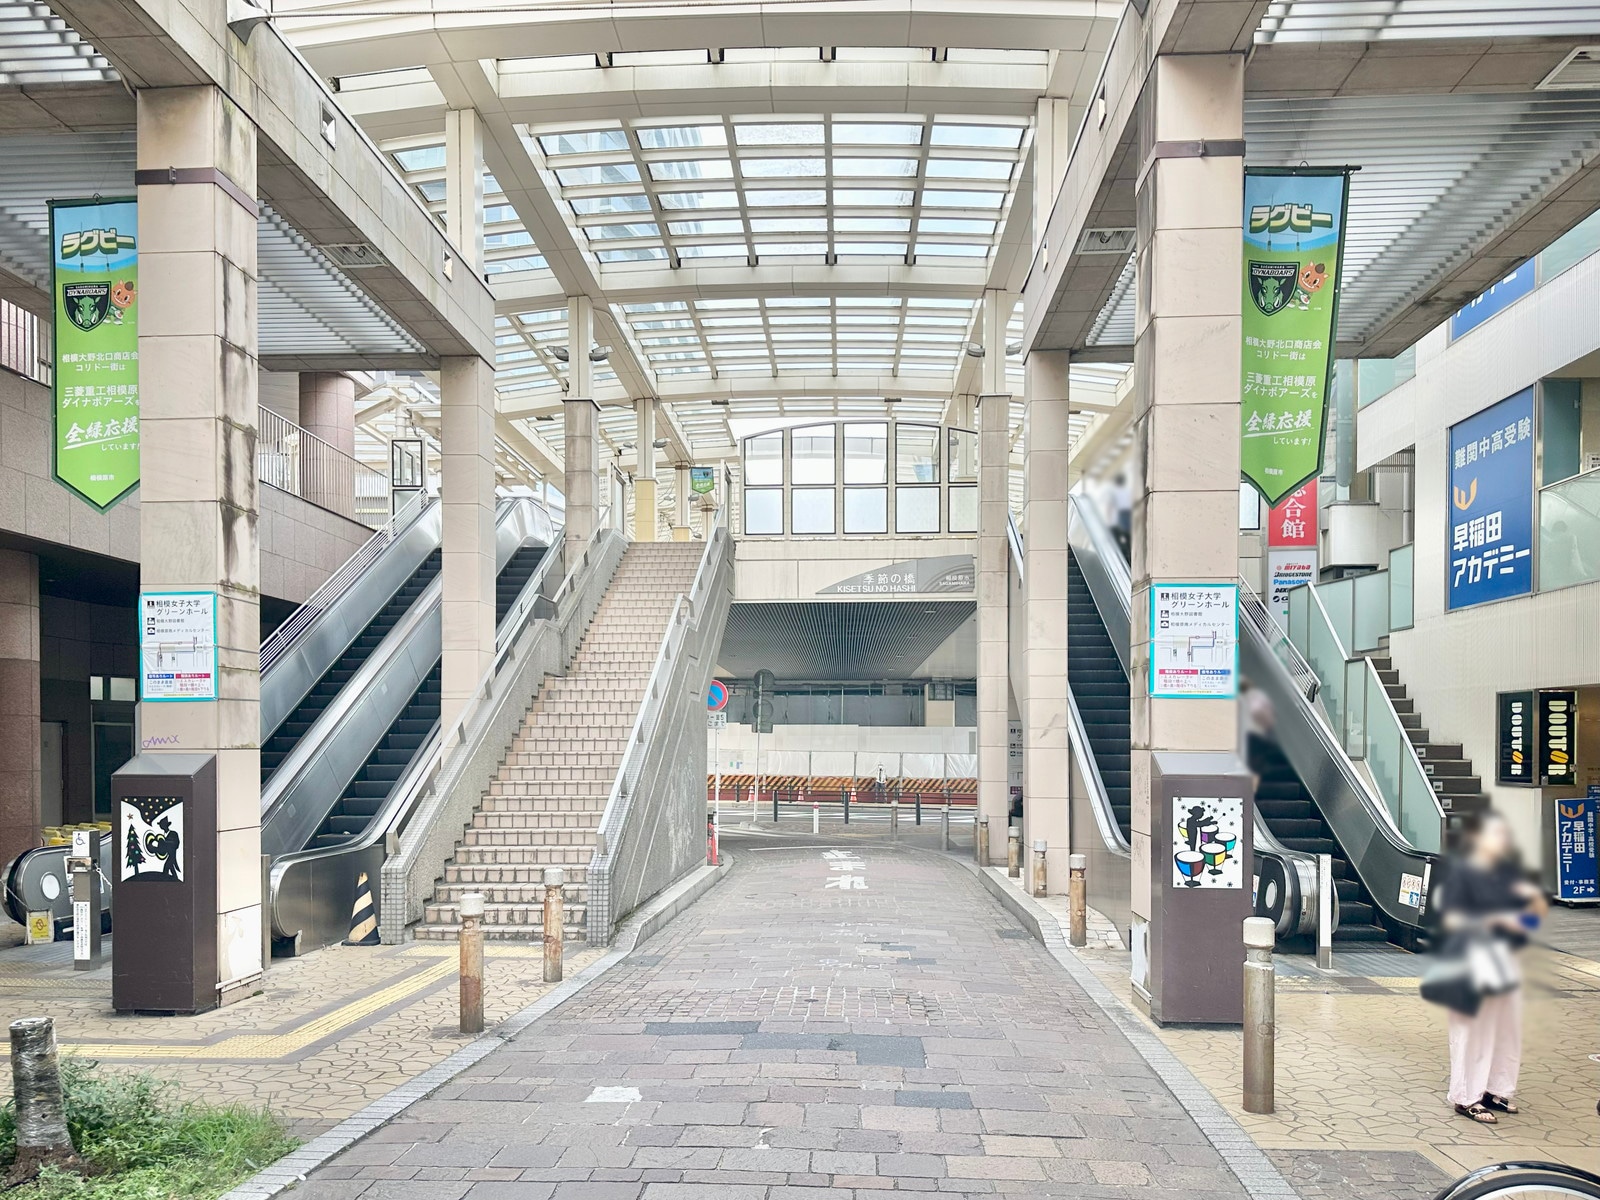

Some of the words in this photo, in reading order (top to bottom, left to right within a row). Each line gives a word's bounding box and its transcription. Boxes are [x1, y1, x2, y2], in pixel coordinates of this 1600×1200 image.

[1249, 203, 1333, 233] ラグビー
[61, 228, 136, 260] ラグビー
[1245, 336, 1322, 350] 相模大野北口商店会
[62, 351, 138, 363] 相模大野北口商店会
[1256, 350, 1306, 360] コリドー街は
[76, 363, 125, 372] コリドー街は
[1246, 371, 1316, 387] 三菱重工相模原
[64, 384, 138, 397] 三菱重工相模原
[1454, 416, 1531, 470] 難関中高受験
[1281, 486, 1307, 539] 合館
[1453, 510, 1502, 552] 早稲田
[1452, 544, 1530, 588] アカデミー
[863, 573, 915, 584] 季節の橋
[837, 585, 874, 593] KISETSU
[876, 585, 888, 593] NO
[890, 585, 916, 593] HASHI
[1171, 592, 1221, 601] 相模女子大学
[156, 600, 201, 608] 相模女子大学
[1171, 601, 1230, 609] グリーンホール
[156, 608, 208, 616] グリーンホール
[1511, 702, 1523, 775] DOUTOR
[1548, 701, 1569, 776] DOUTOR
[1573, 821, 1586, 853] 早稲田
[1561, 821, 1573, 873] アカデミー
[1573, 886, 1586, 894] 2F
